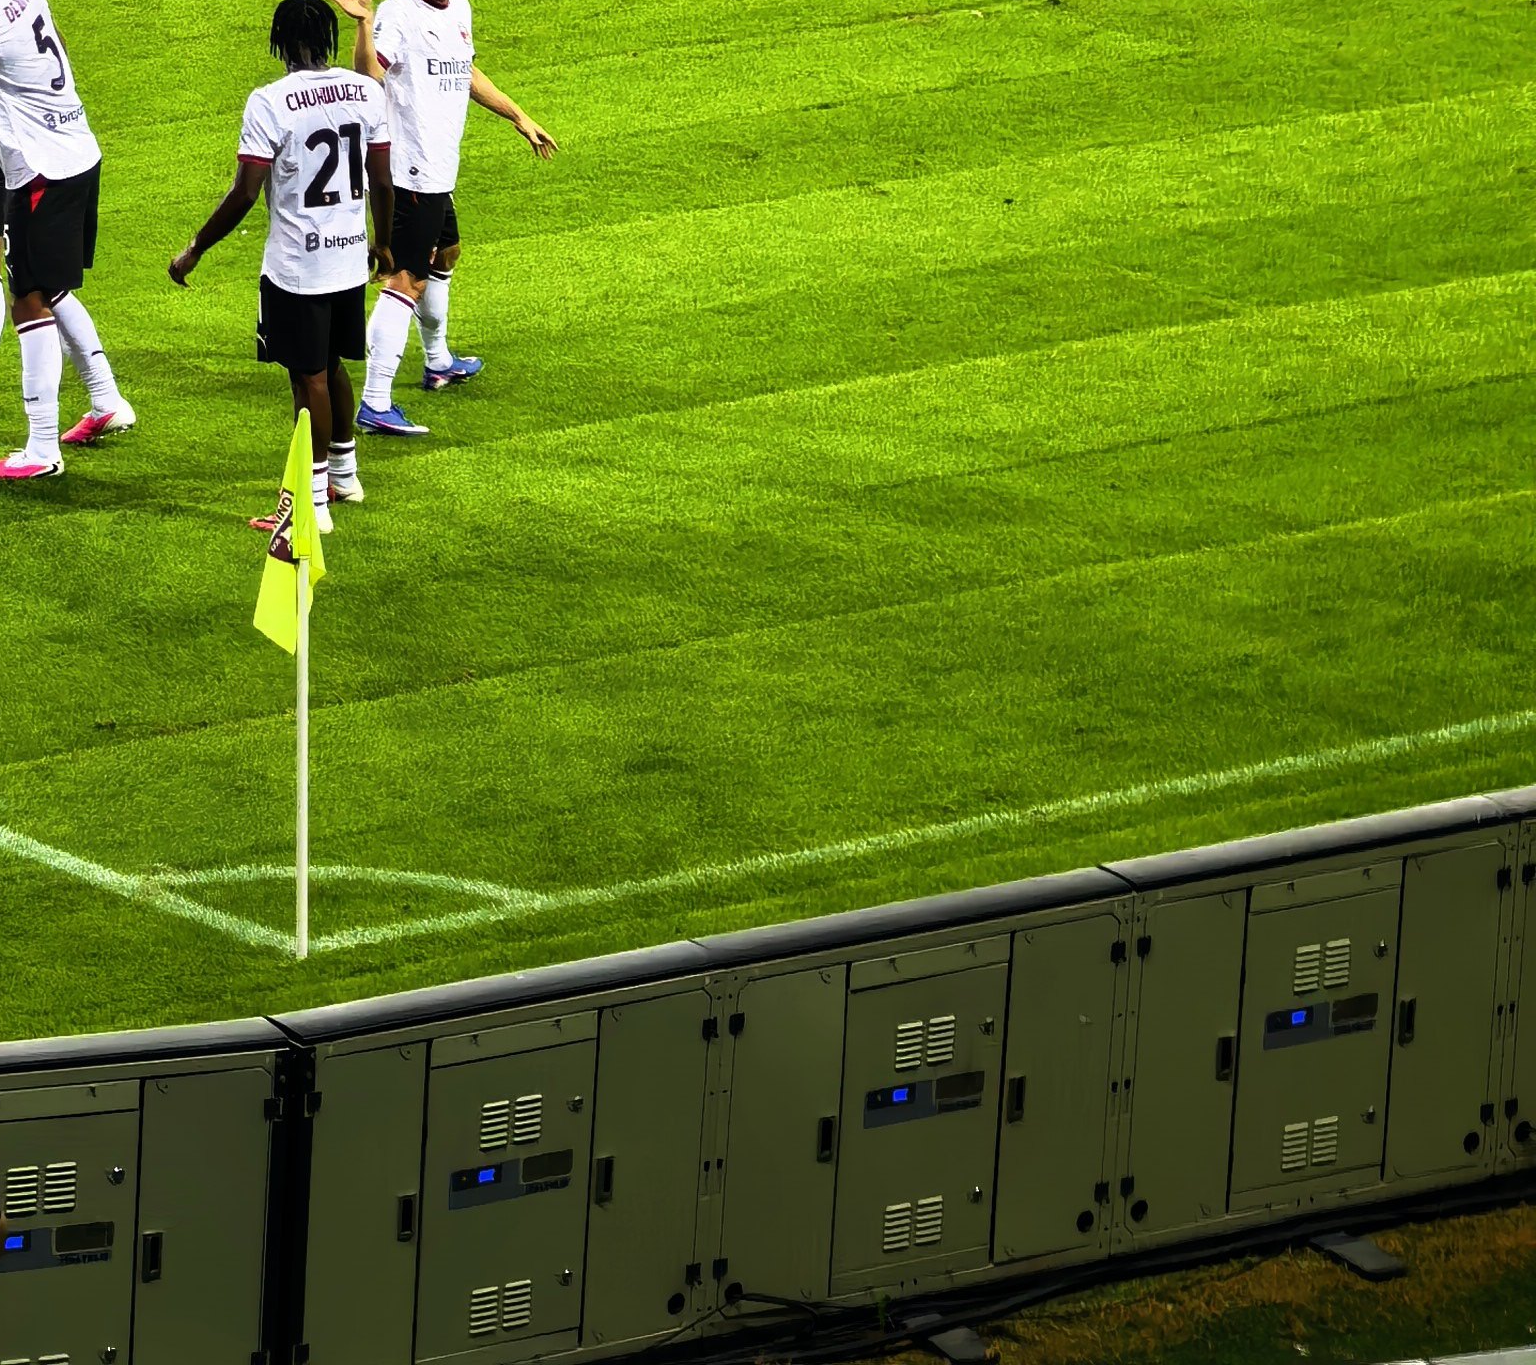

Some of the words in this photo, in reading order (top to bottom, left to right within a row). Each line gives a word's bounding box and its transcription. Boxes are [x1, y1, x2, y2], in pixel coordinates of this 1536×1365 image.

[31, 13, 66, 91] 5
[426, 57, 472, 76] Emira
[303, 122, 364, 209] 21
